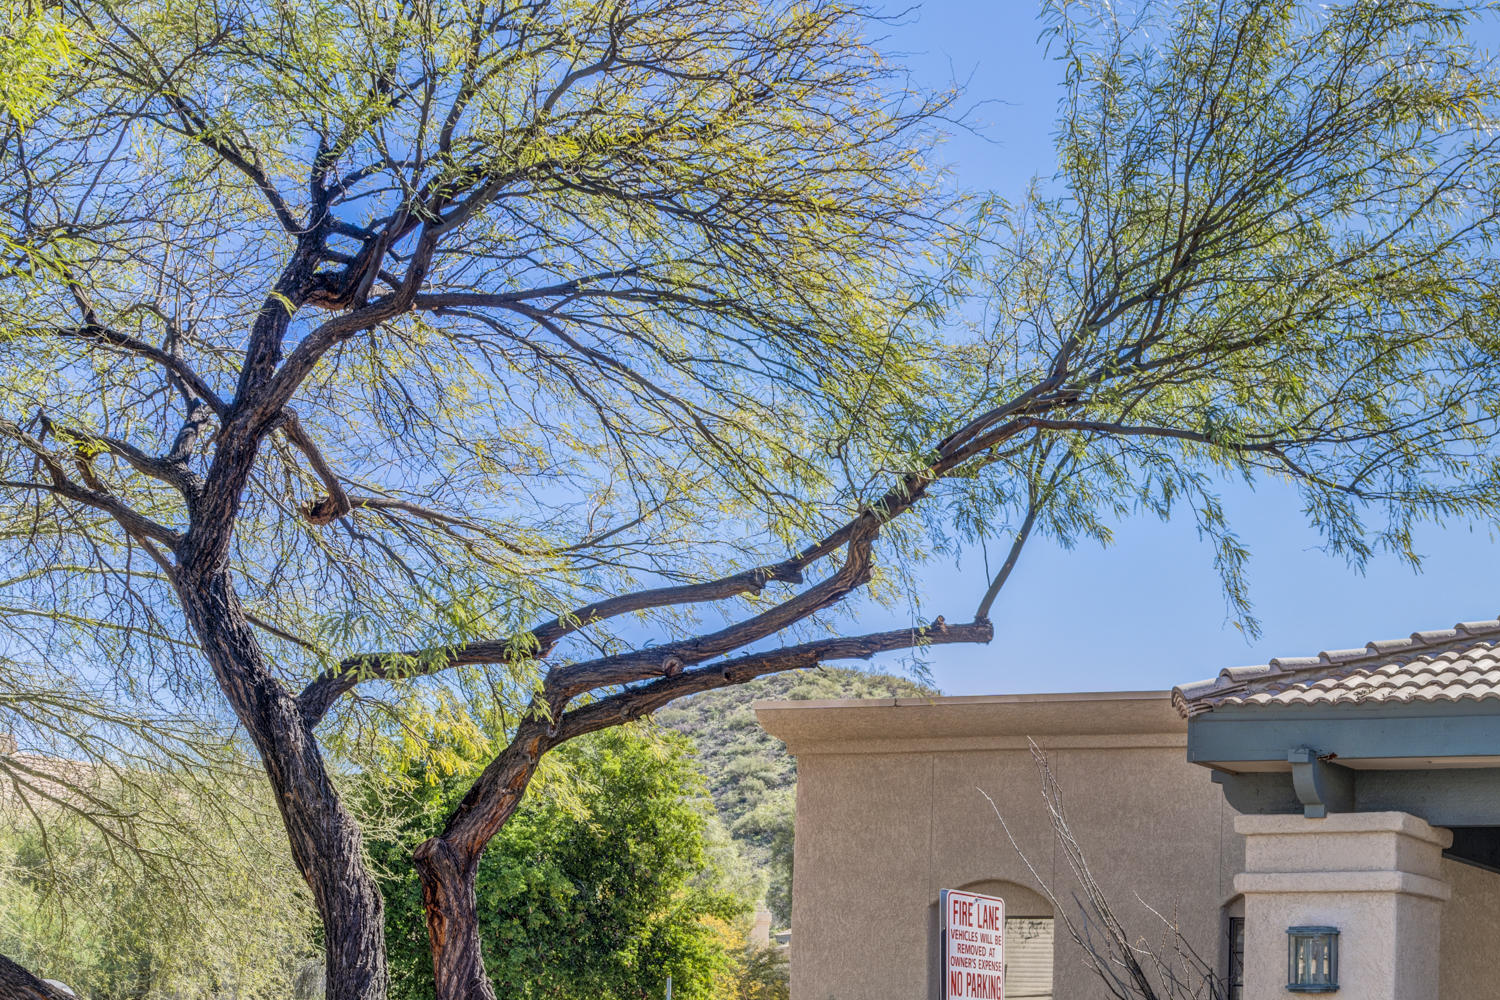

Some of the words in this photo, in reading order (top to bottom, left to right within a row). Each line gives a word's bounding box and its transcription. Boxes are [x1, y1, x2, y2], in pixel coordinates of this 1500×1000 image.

[953, 899, 973, 927] FIRE
[977, 903, 999, 931] LANE
[951, 928, 978, 943] VEHICLES
[980, 932, 993, 945] WILL
[995, 935, 1002, 946] BE
[957, 943, 986, 957] REMOVED
[989, 948, 996, 958] AT
[951, 956, 976, 969] OWNER'S
[978, 960, 1001, 972] EXPENSE
[951, 970, 963, 997] NO
[966, 971, 1001, 1000] PARKING
